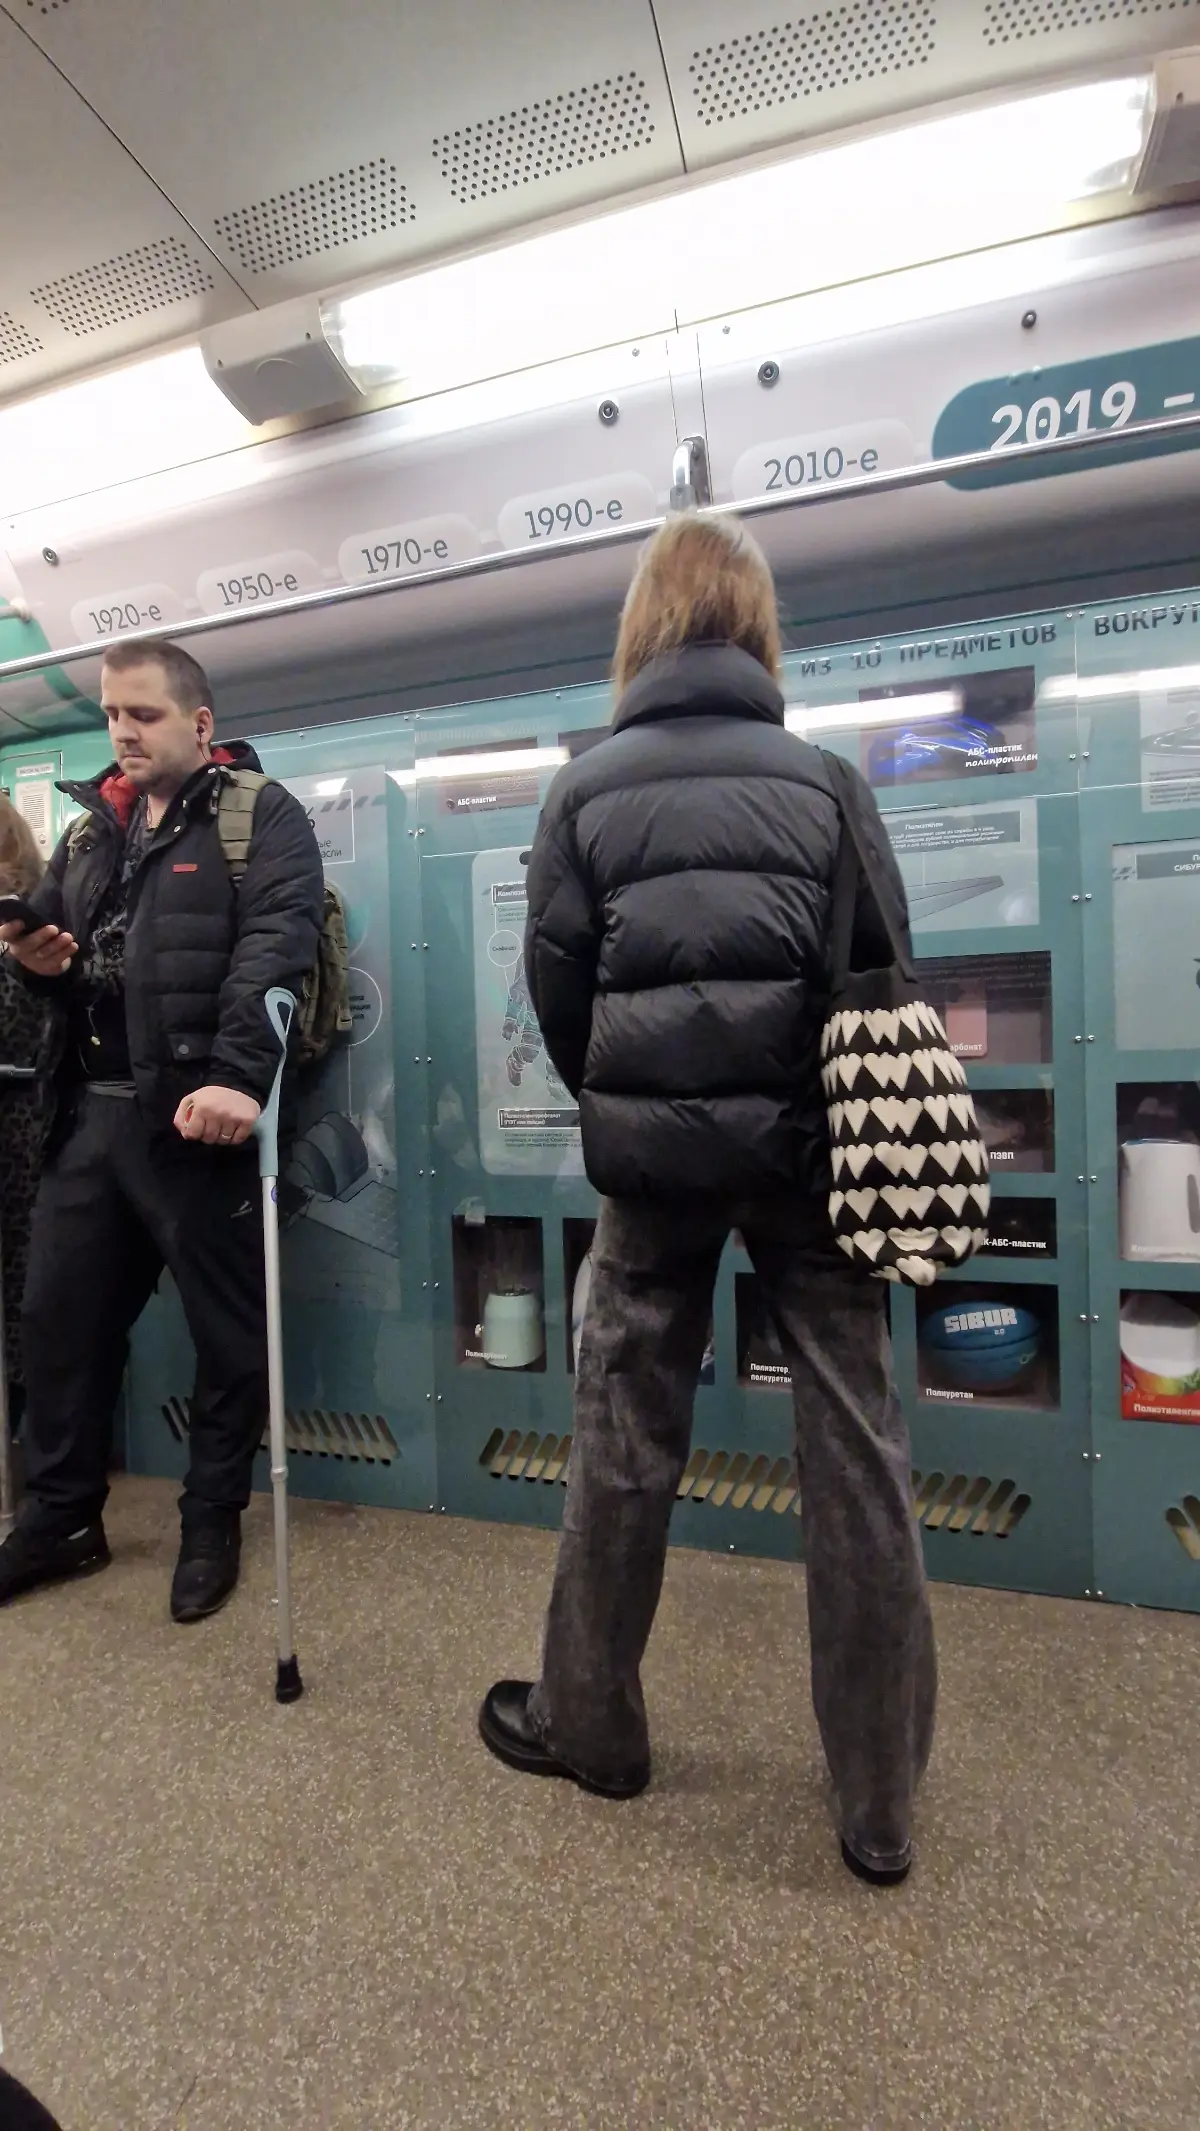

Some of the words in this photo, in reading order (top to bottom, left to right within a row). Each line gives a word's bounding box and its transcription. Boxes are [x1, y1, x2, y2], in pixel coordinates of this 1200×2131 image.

[990, 381, 1137, 451] 2019
[763, 446, 879, 491] 2010-е
[524, 498, 623, 539] 1990-е
[361, 538, 449, 574] 1970-е
[216, 572, 299, 606] 1950-е
[89, 603, 162, 634] 1920-е
[801, 658, 832, 677] ИЗ
[851, 650, 882, 671] 10
[901, 623, 1057, 663] ПРЕДМЕТОВ
[965, 753, 1039, 768] полипропилен
[967, 744, 1023, 757] АБС-пластик
[457, 796, 497, 807] АБС-пластик
[950, 1043, 983, 1052] арбонат
[990, 1151, 1014, 1160] ПЭВП
[982, 1238, 1047, 1249] К-АБС-пластик
[944, 1308, 1018, 1335] SIBUR
[750, 1374, 793, 1384] полиуретан
[926, 1387, 974, 1400] Полиуретан
